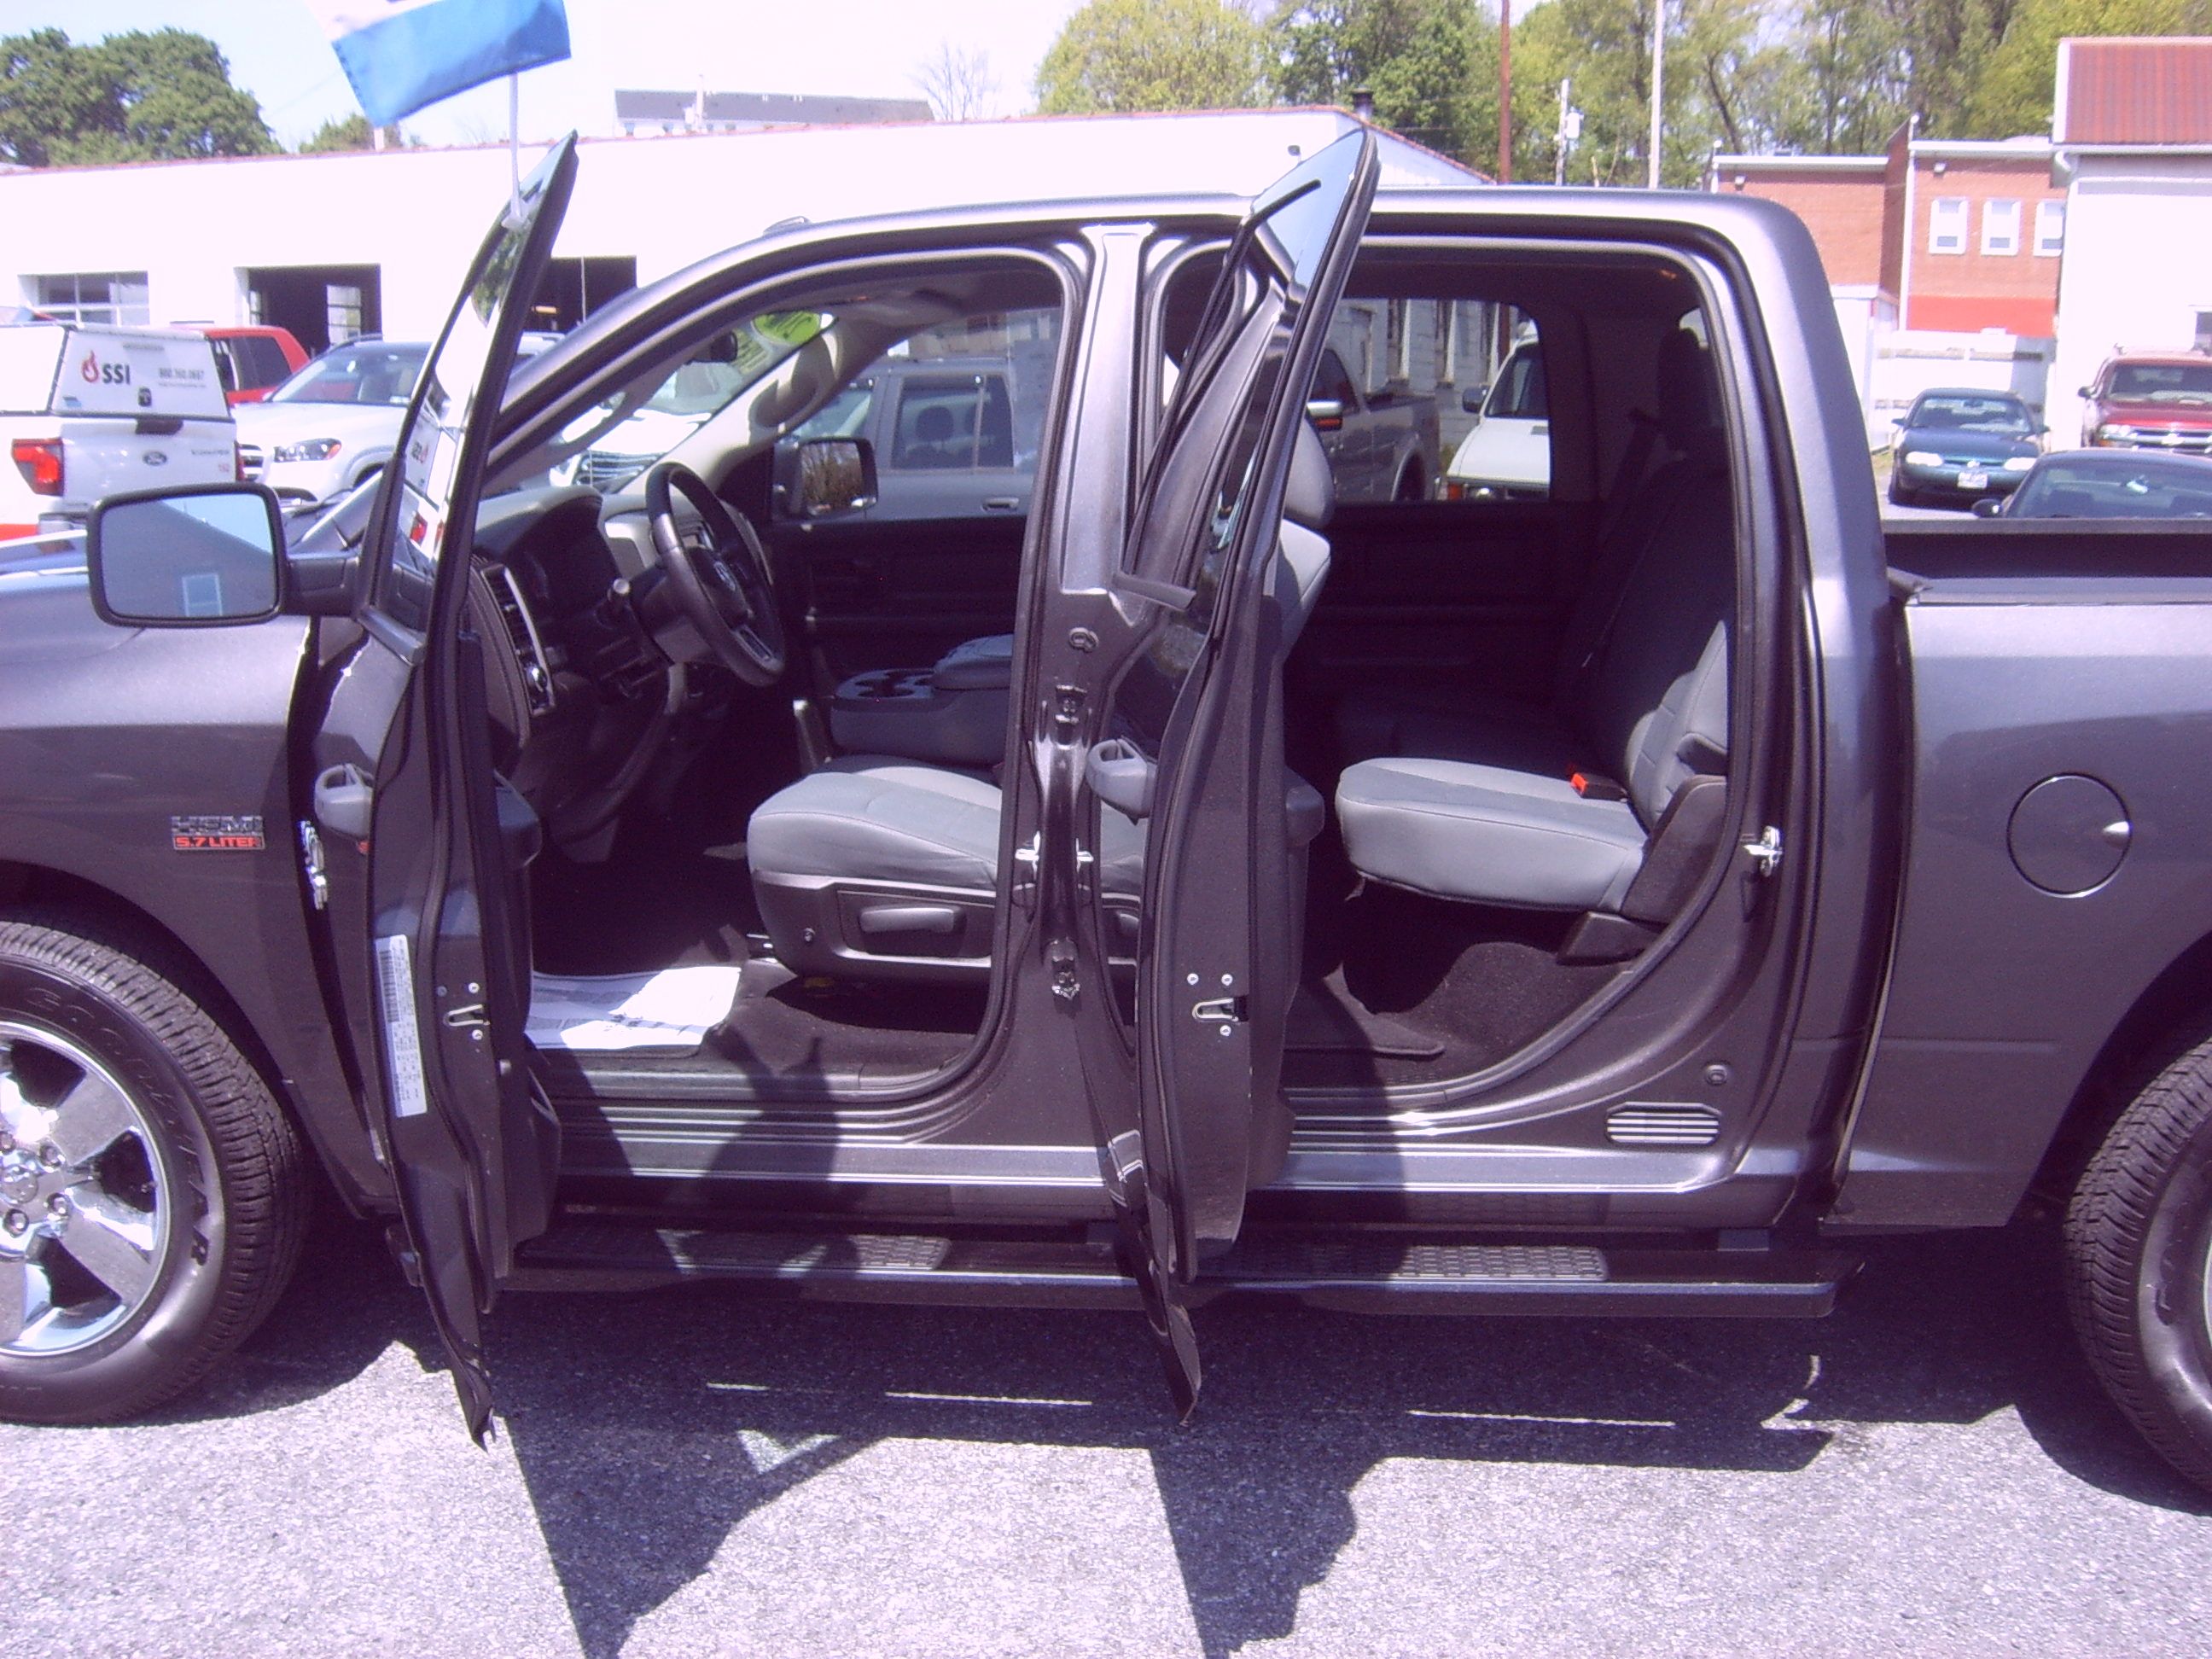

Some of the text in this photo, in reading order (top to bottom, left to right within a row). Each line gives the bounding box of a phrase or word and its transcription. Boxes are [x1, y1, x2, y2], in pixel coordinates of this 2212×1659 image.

[102, 364, 130, 385] SSI
[176, 837, 260, 847] 5.7 LITER
